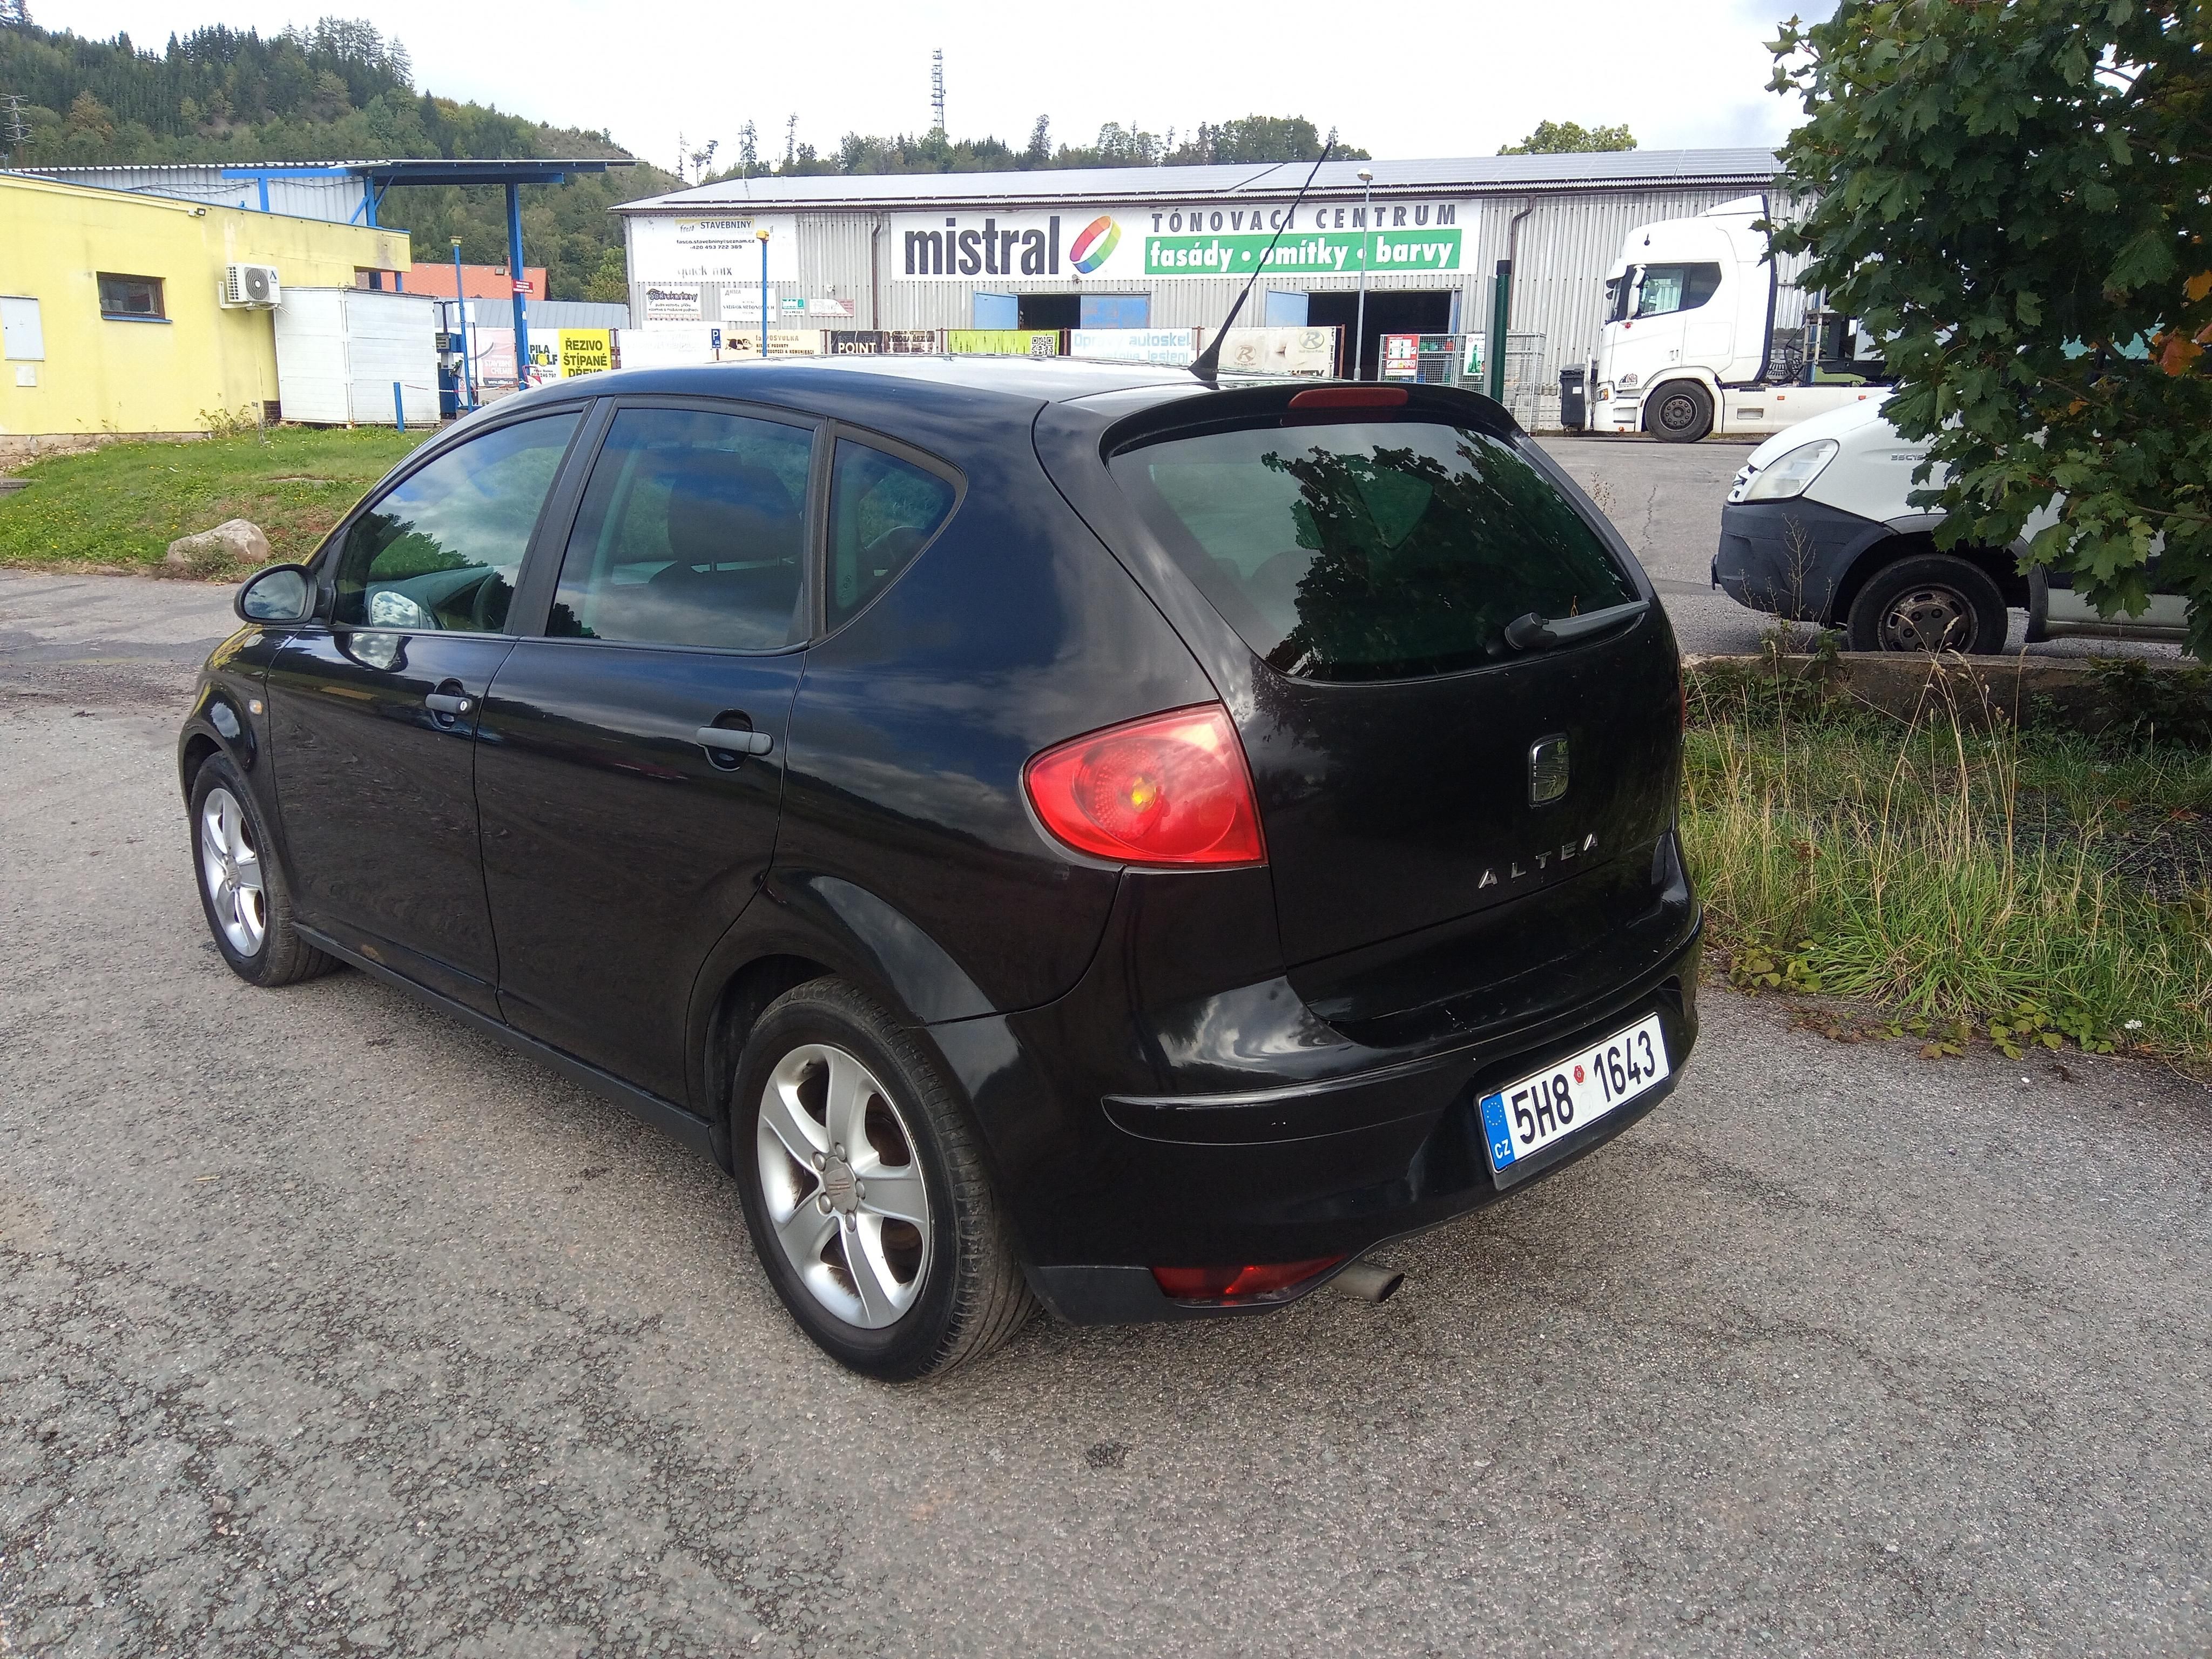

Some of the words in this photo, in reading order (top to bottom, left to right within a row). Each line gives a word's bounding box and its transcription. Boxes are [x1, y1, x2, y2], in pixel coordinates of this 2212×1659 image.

[700, 220, 752, 229] STAVEBNINY
[1316, 205, 1455, 228] CENTRUM
[905, 216, 1061, 275] mistral
[1150, 239, 1234, 273] fasády
[1259, 237, 1349, 271] omítky
[1375, 235, 1454, 268] barvy
[712, 330, 719, 341] P
[529, 345, 550, 354] PILA
[565, 338, 603, 351] ŘEZIVO
[838, 342, 876, 354] POINT
[563, 353, 608, 366] ŠTÍPANÉ
[1478, 832, 1599, 889] ALTEA
[1511, 1074, 1574, 1144] 5H8
[1593, 1030, 1656, 1103] 1643
[1494, 1139, 1511, 1159] CZ
